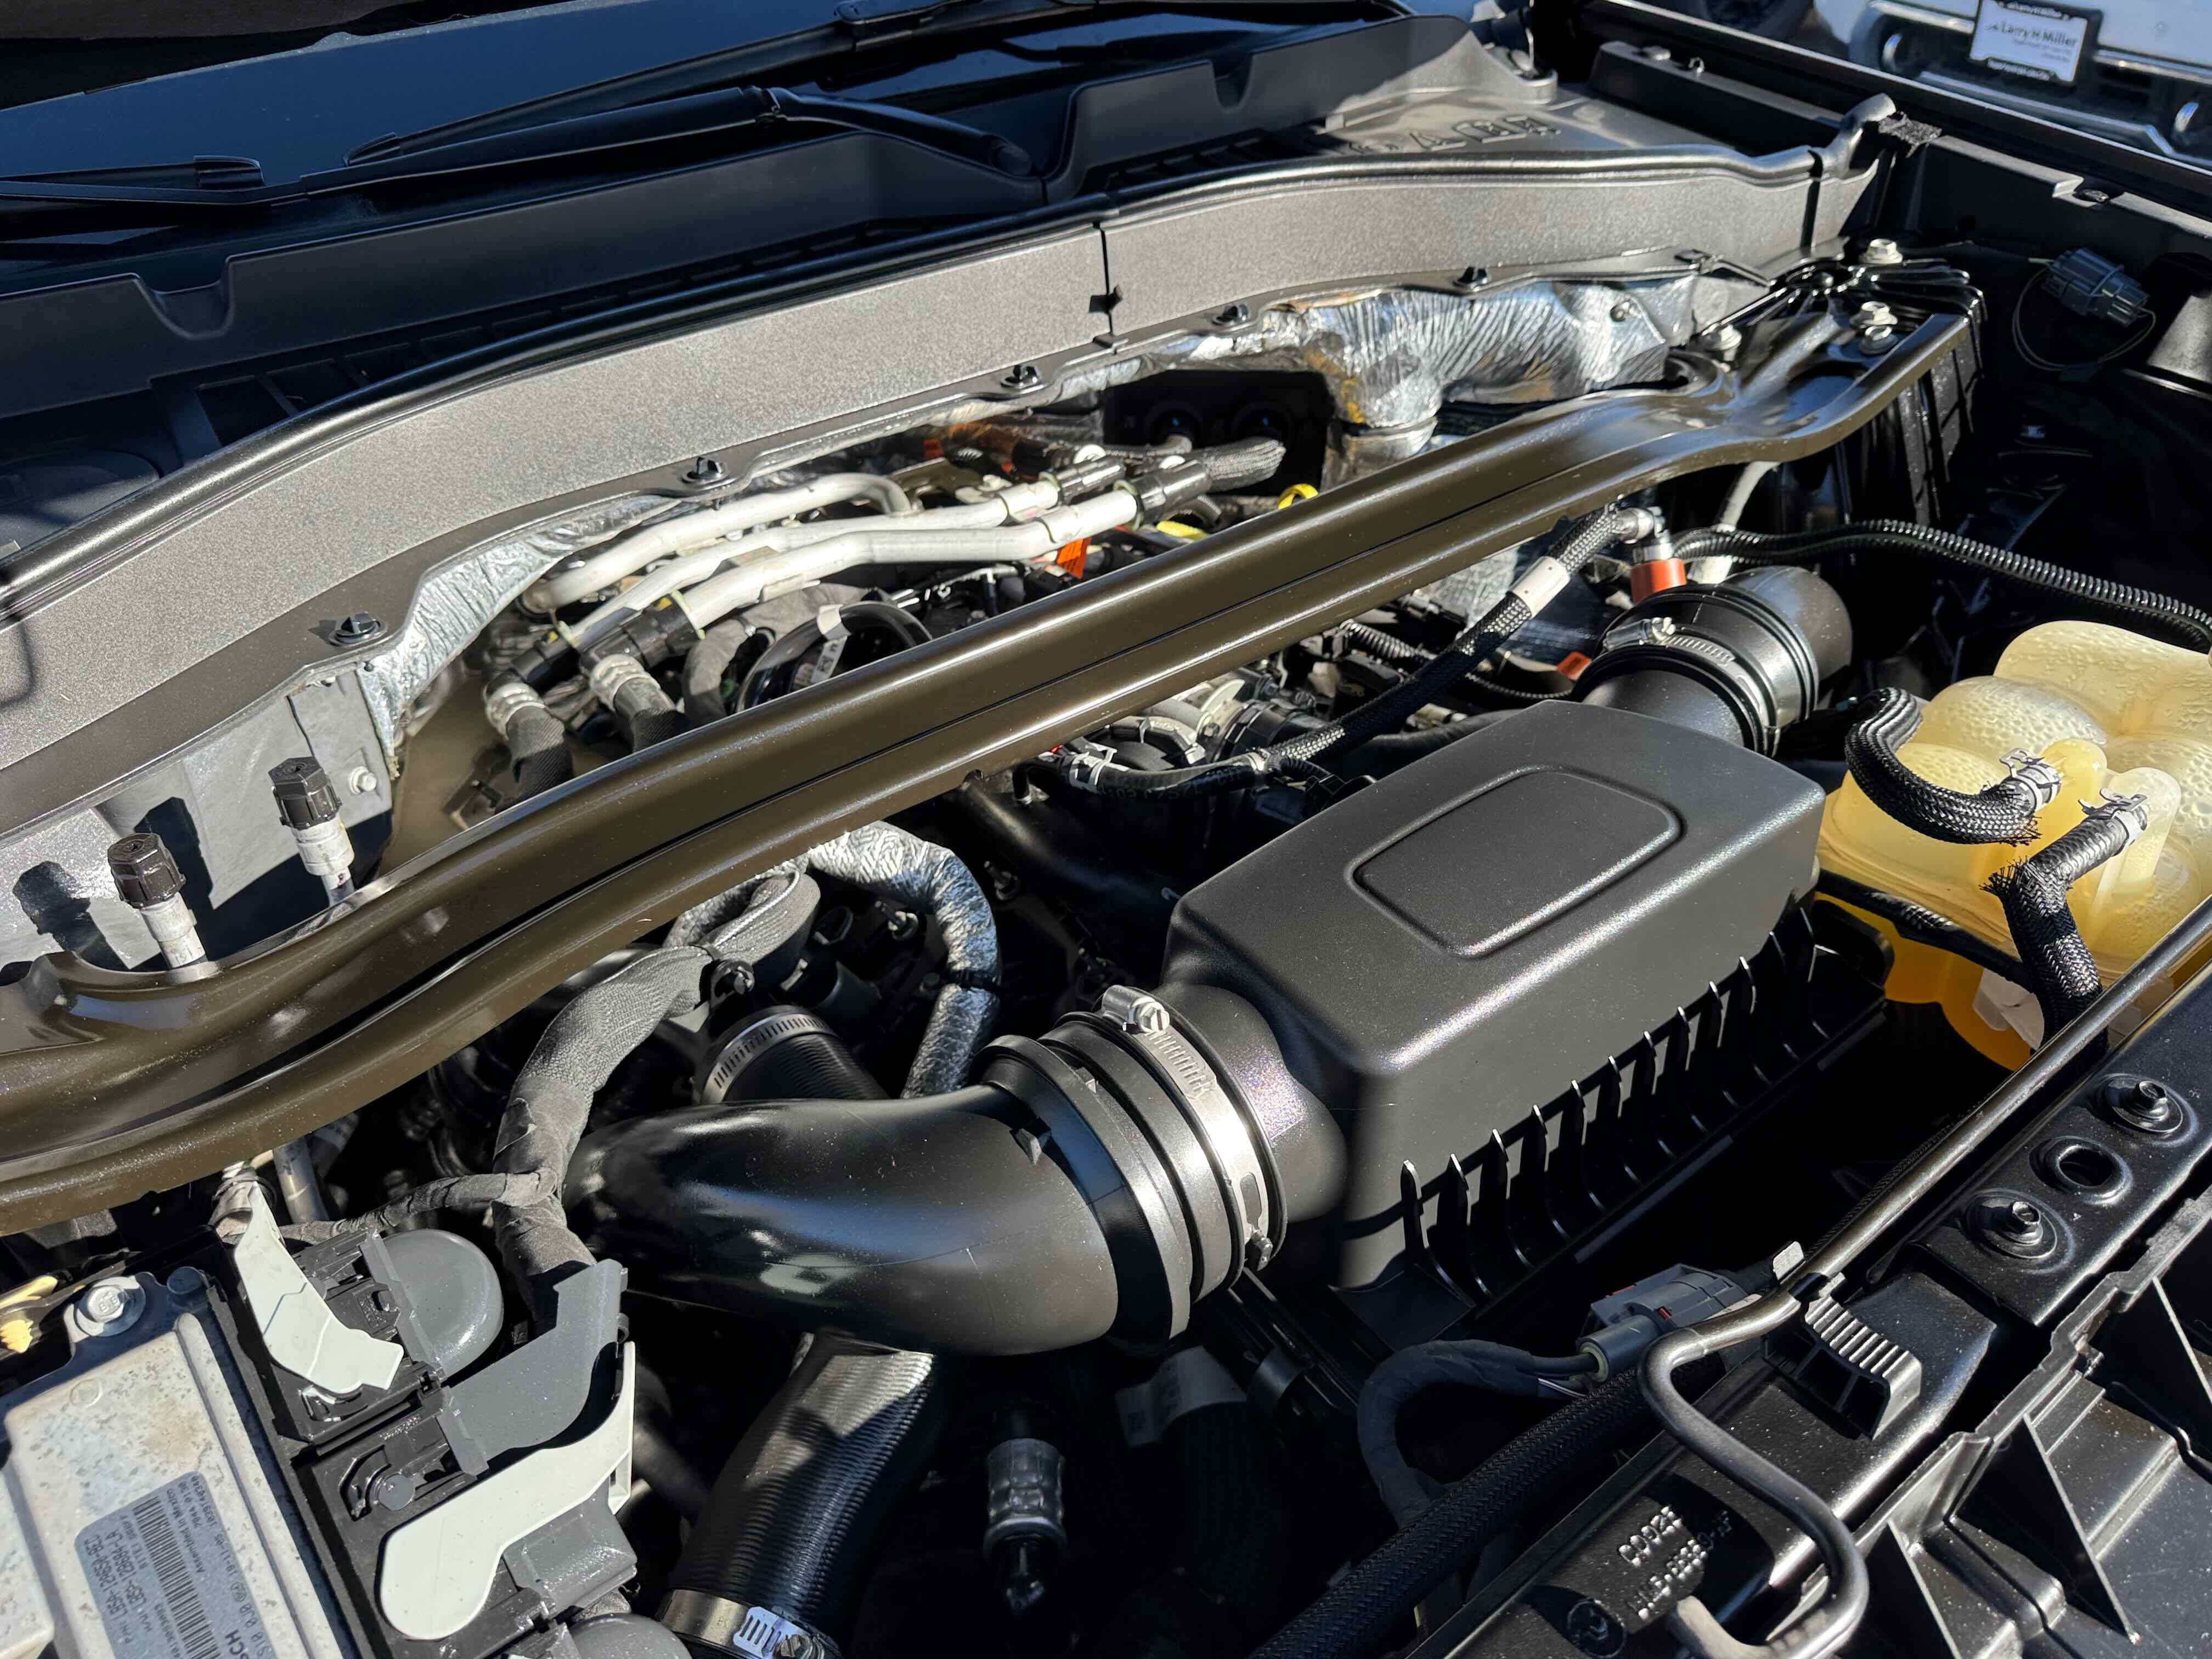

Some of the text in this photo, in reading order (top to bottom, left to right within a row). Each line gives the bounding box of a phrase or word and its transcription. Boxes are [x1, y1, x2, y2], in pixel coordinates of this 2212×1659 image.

[2001, 19, 2029, 38] Larry
[2042, 29, 2078, 47] Miller
[166, 1488, 184, 1517] Mexico
[180, 1528, 205, 1574] Assembled
